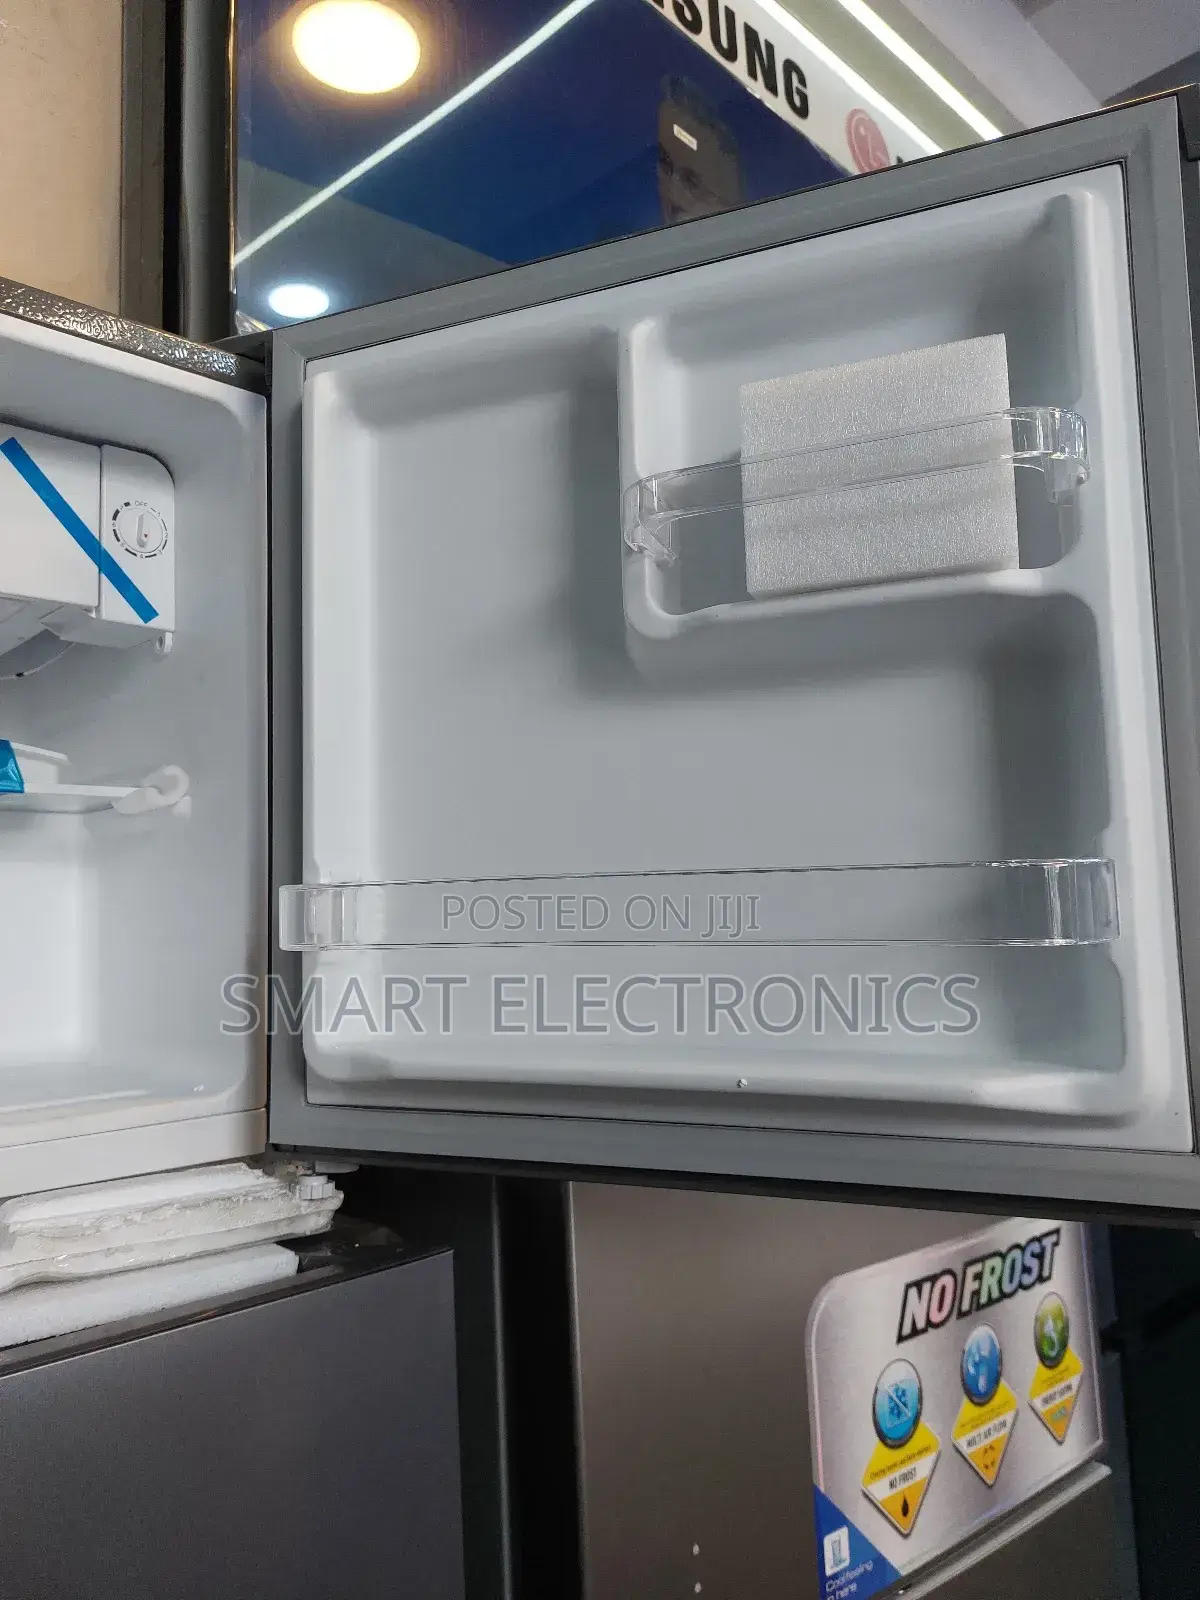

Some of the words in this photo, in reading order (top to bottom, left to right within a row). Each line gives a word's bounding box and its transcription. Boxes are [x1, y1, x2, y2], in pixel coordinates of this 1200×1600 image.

[652, 0, 809, 120] SUNG
[896, 1268, 957, 1345] NO
[955, 1227, 1061, 1319] FROST
